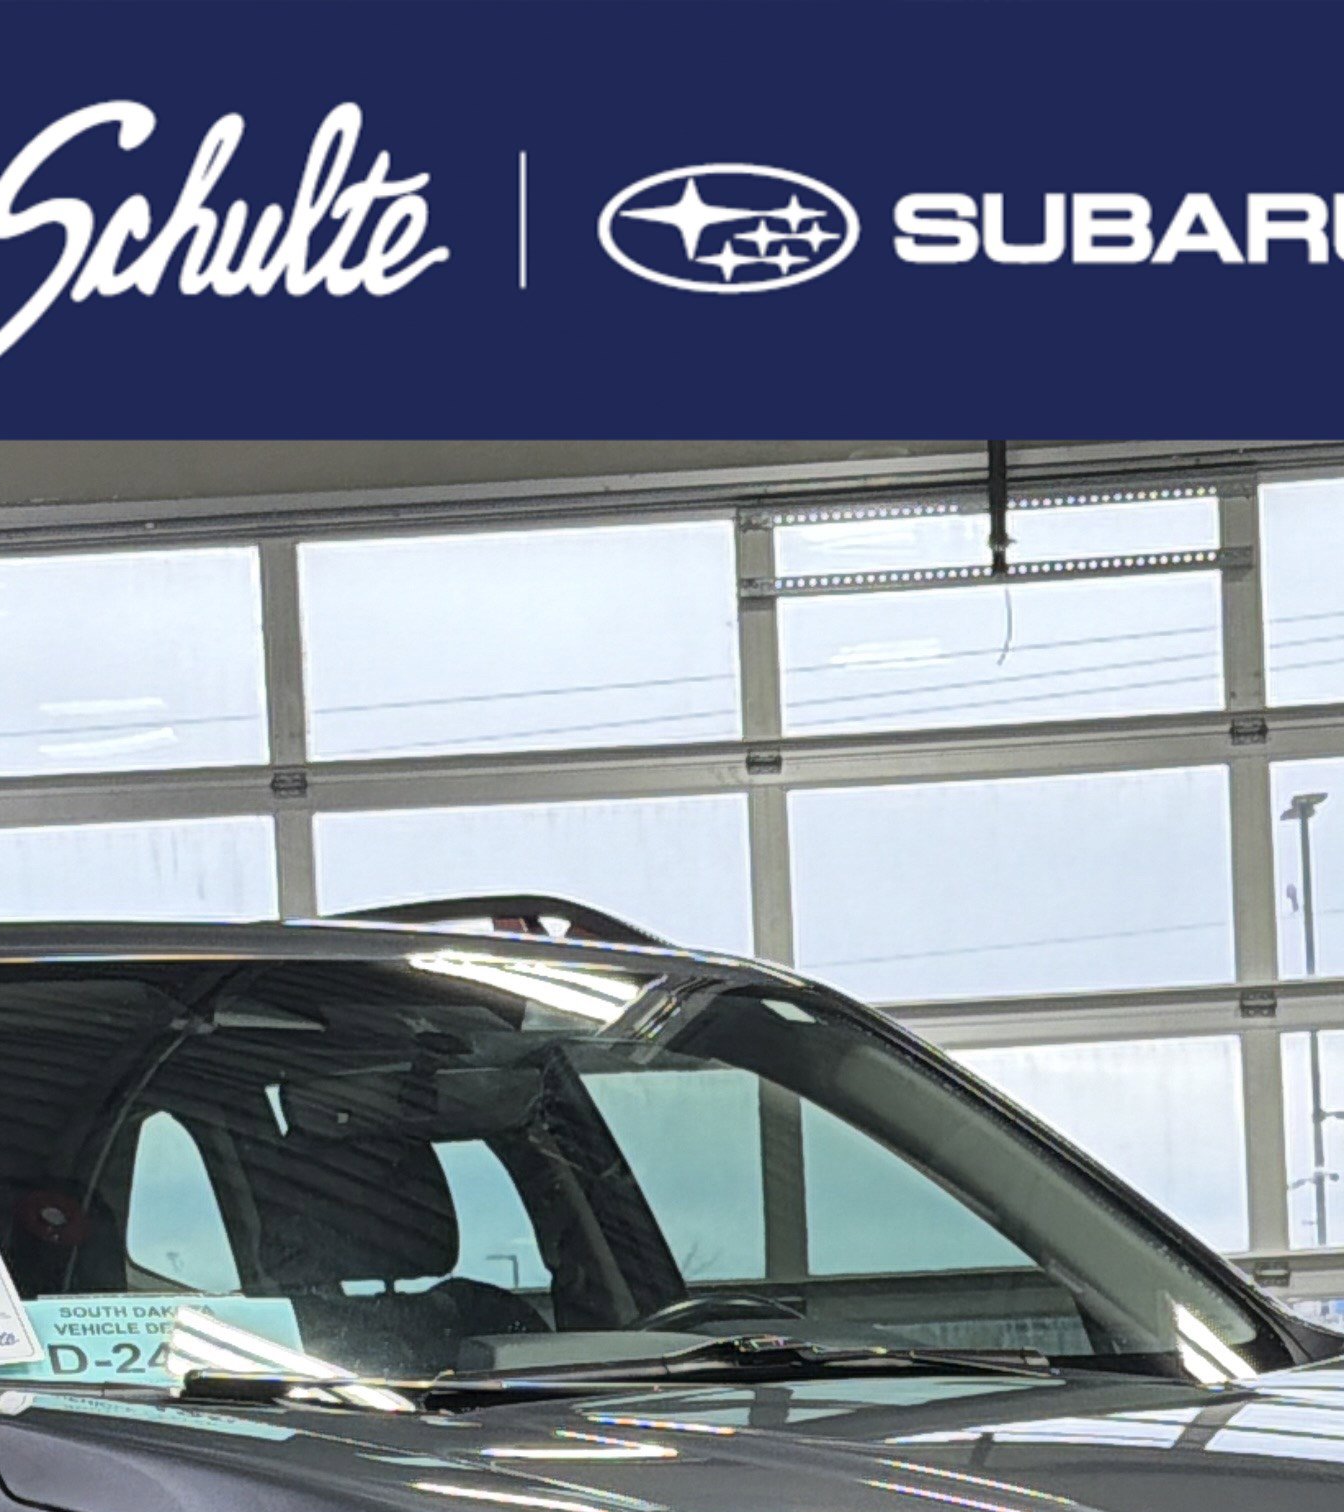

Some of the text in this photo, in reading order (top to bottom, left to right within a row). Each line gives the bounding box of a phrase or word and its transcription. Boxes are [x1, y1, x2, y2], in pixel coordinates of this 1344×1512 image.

[59, 1305, 128, 1319] SOUTH
[54, 1321, 141, 1337] VEHICLE
[47, 1342, 171, 1375] D-24
